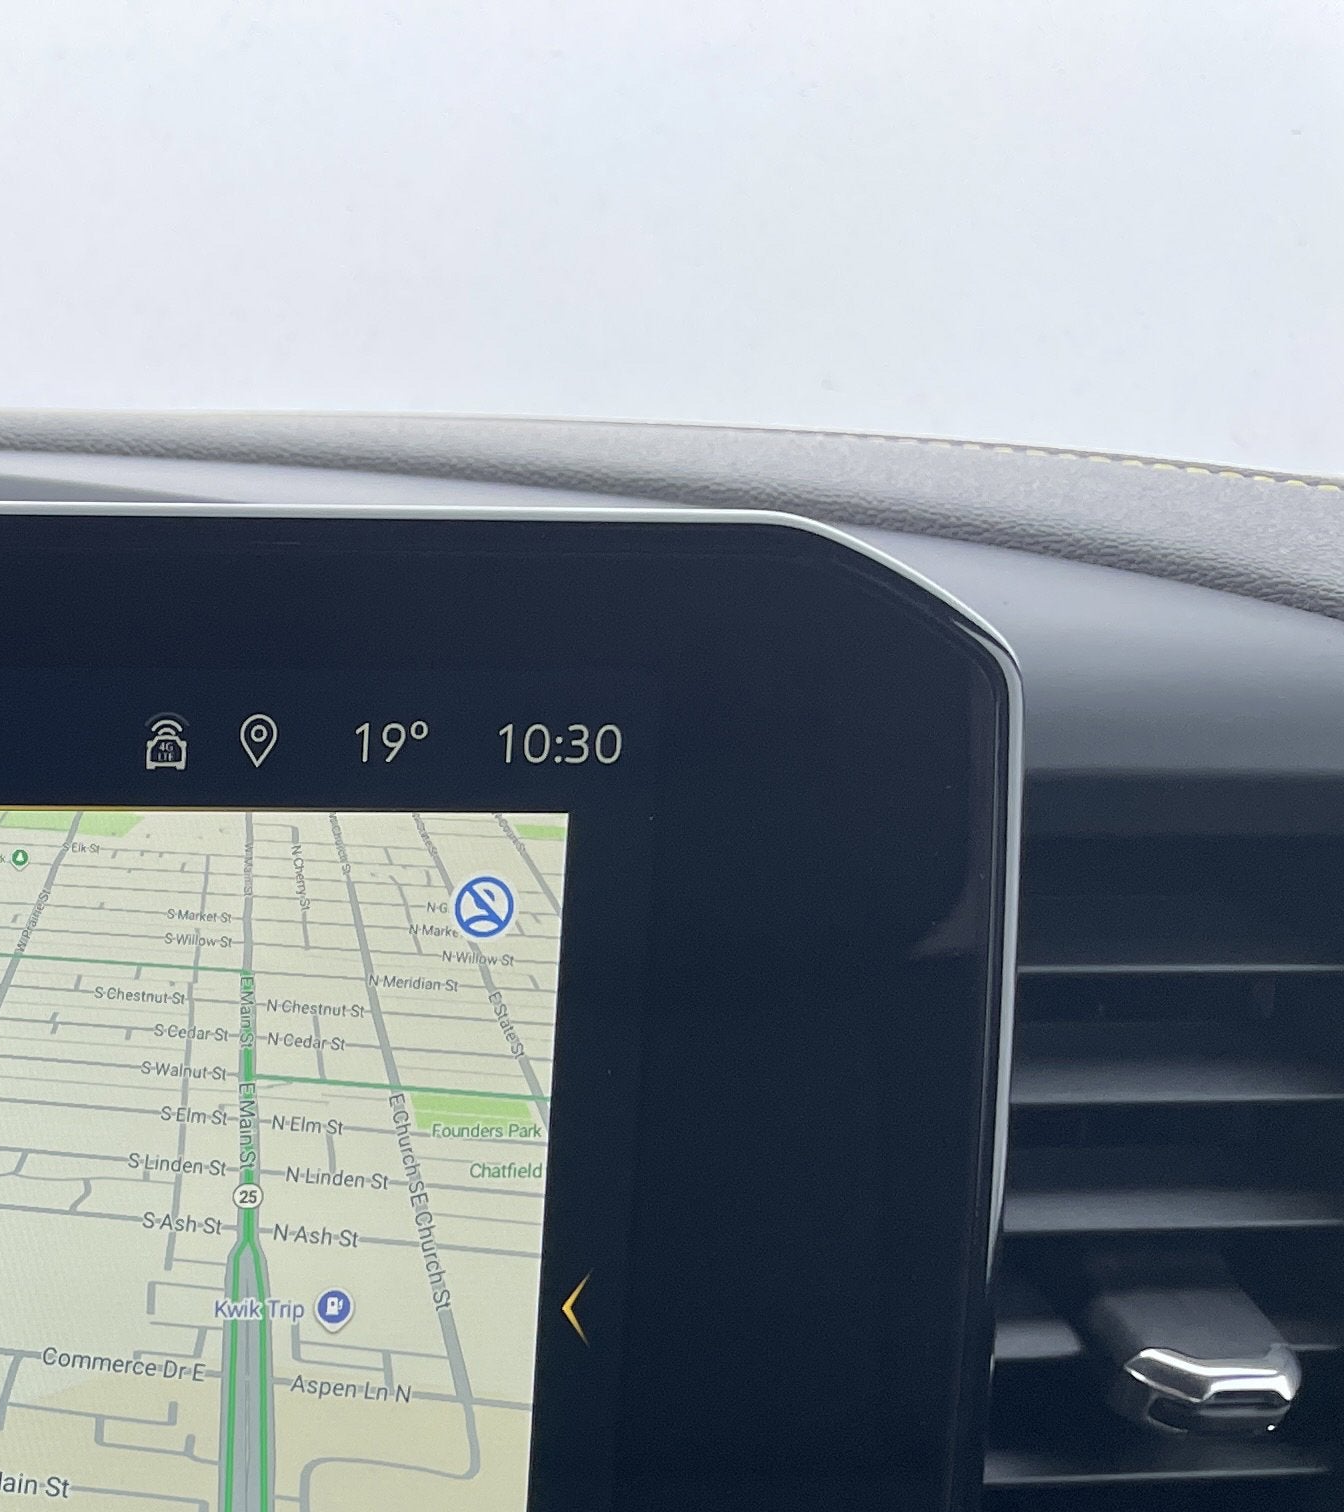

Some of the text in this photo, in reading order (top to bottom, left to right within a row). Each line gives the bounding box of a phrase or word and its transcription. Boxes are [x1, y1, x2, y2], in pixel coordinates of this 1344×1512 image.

[159, 742, 173, 751] 4G
[498, 724, 621, 764] 10:30
[267, 1000, 364, 1017] N Chestnut St
[239, 1083, 256, 1169] E Main St
[272, 1115, 343, 1135] N Elm St
[432, 1123, 542, 1138] Founders Park
[286, 1166, 389, 1190] N Linden St
[470, 1162, 543, 1179] Chatfield
[239, 1190, 257, 1204] 25
[142, 1212, 223, 1235] S Ash St
[273, 1224, 359, 1248] N Ash St
[410, 1194, 452, 1311] E Church St
[214, 1299, 305, 1320] Kwik Trip
[42, 1347, 205, 1382] Commerce Dr E
[290, 1375, 412, 1402] Aspen Ln N
[43, 1476, 70, 1498] St
